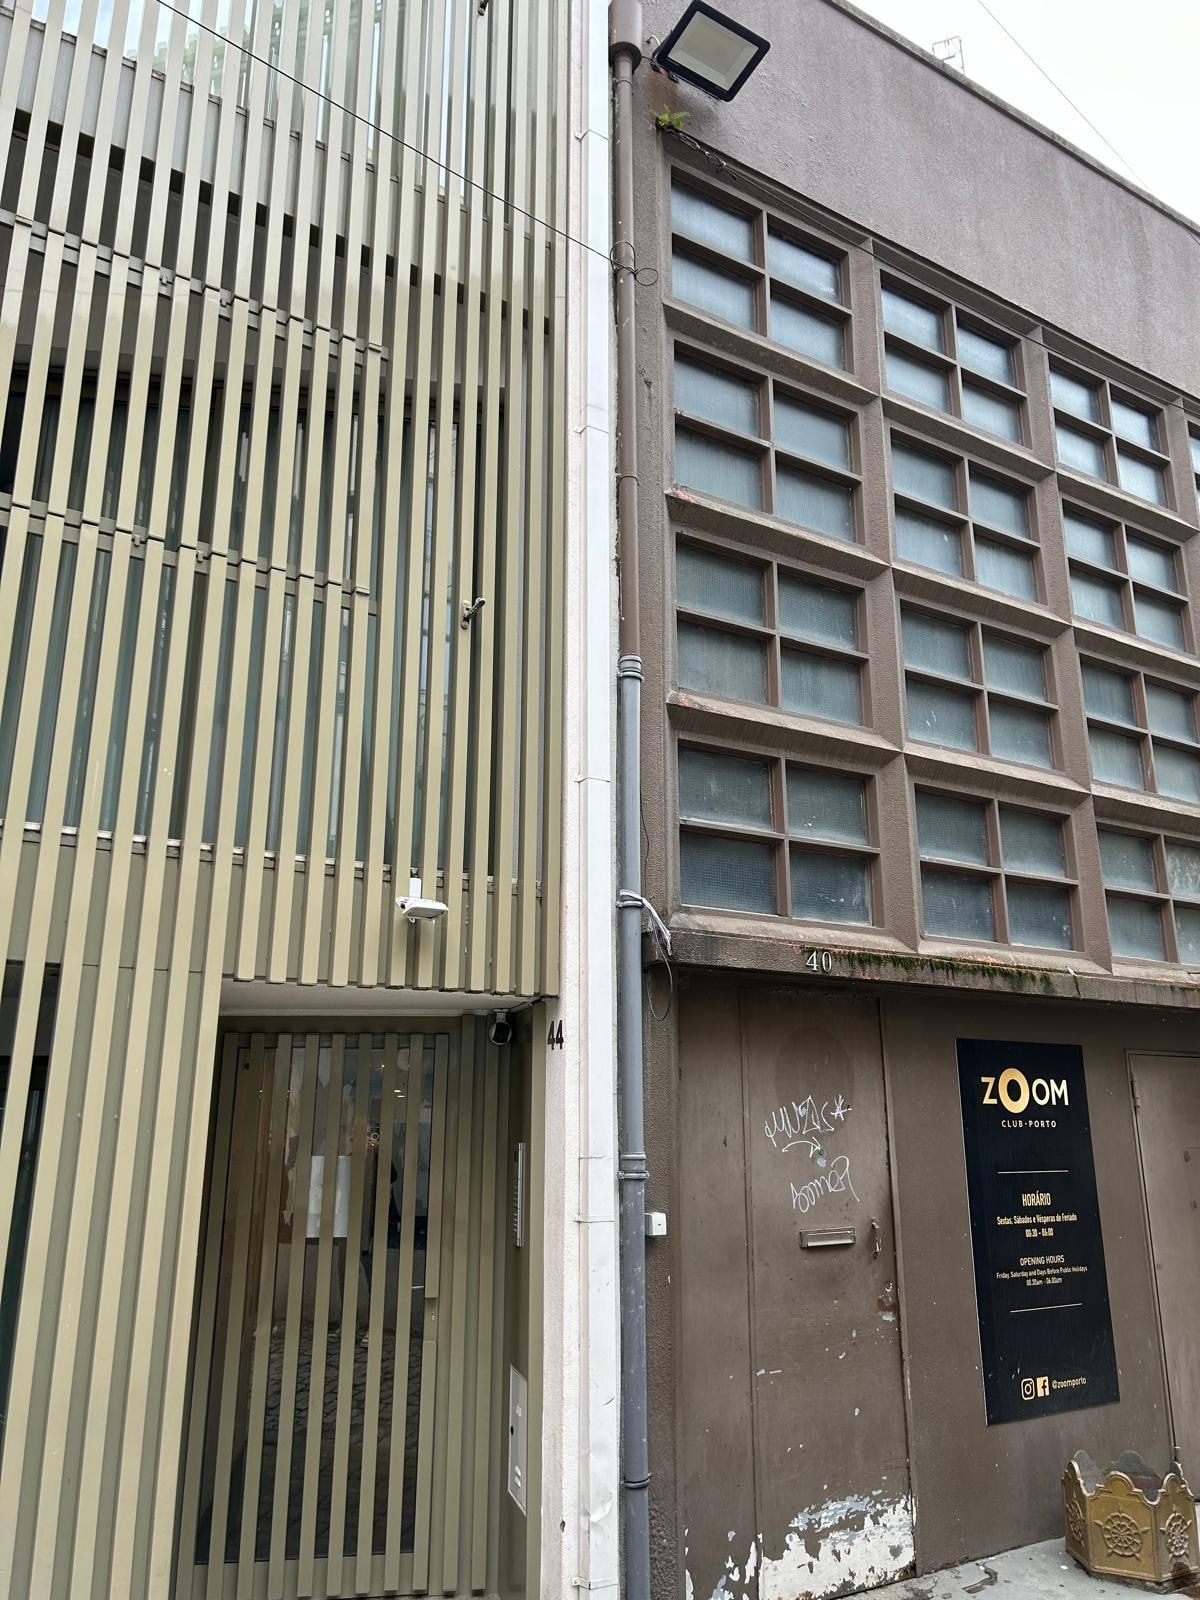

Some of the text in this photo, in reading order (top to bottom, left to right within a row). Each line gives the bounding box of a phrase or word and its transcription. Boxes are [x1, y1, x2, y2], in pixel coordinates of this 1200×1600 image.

[805, 950, 832, 973] 40
[547, 1020, 564, 1050] 44
[981, 1068, 1069, 1113] ZOOM
[1022, 1190, 1051, 1206] HORÁRIO
[1020, 1254, 1065, 1266] OPENING HOURS
[1052, 1376, 1087, 1389] @zoomporto
